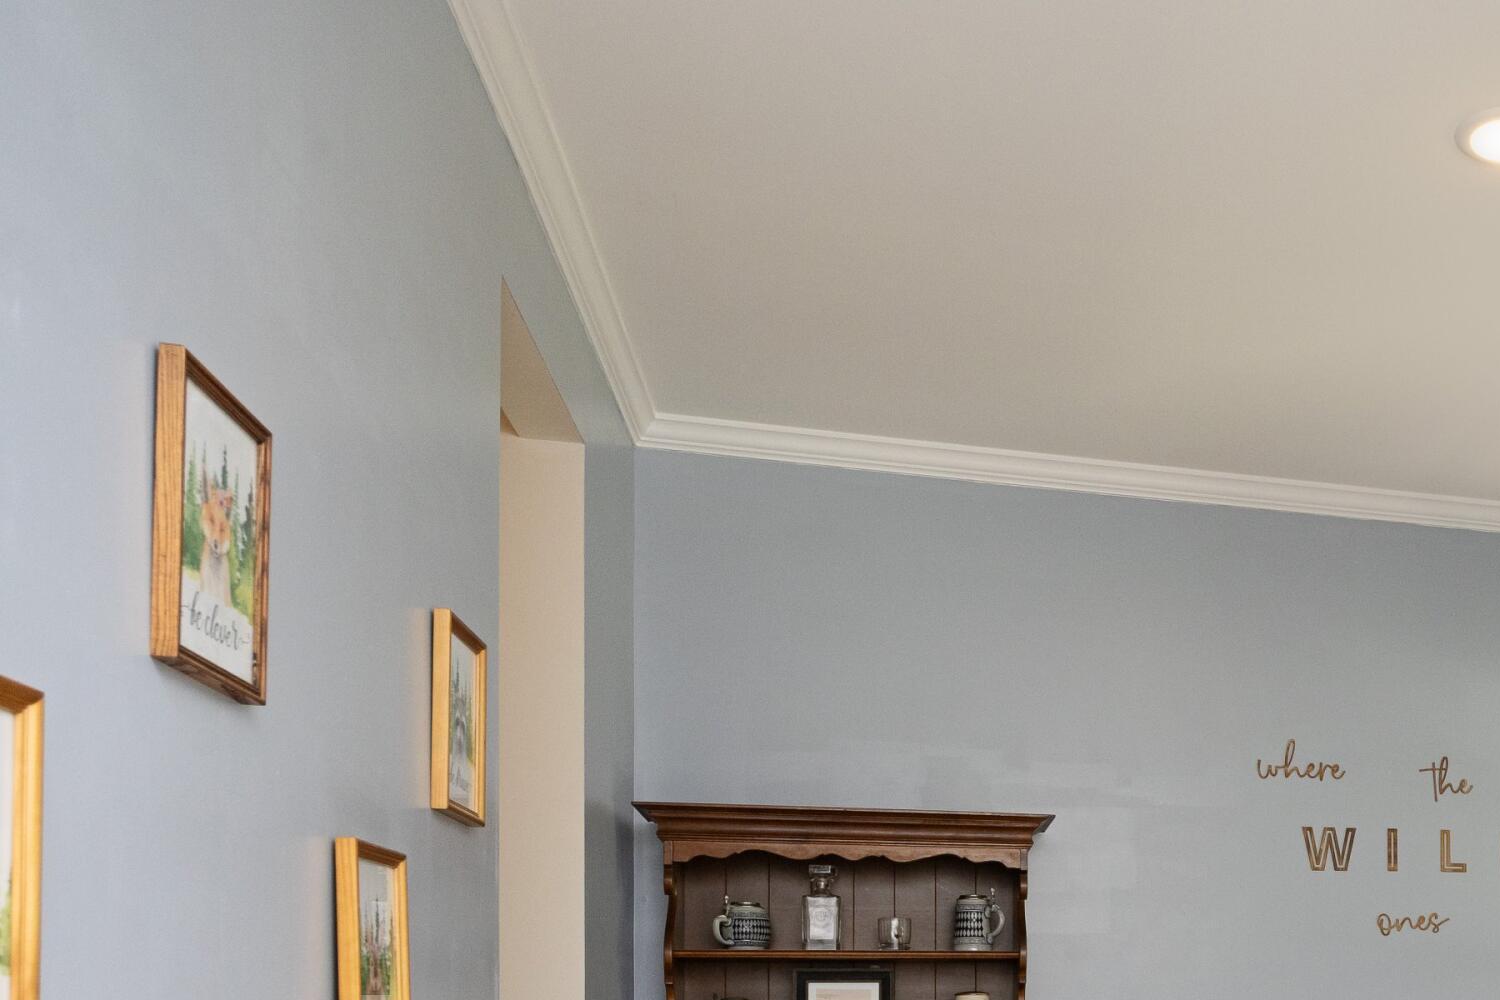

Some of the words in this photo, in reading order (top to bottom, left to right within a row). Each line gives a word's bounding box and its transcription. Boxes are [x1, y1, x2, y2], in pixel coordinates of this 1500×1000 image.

[204, 604, 239, 650] clever
[1257, 739, 1346, 782] where
[1419, 756, 1474, 802] the
[1377, 911, 1450, 936] ones
